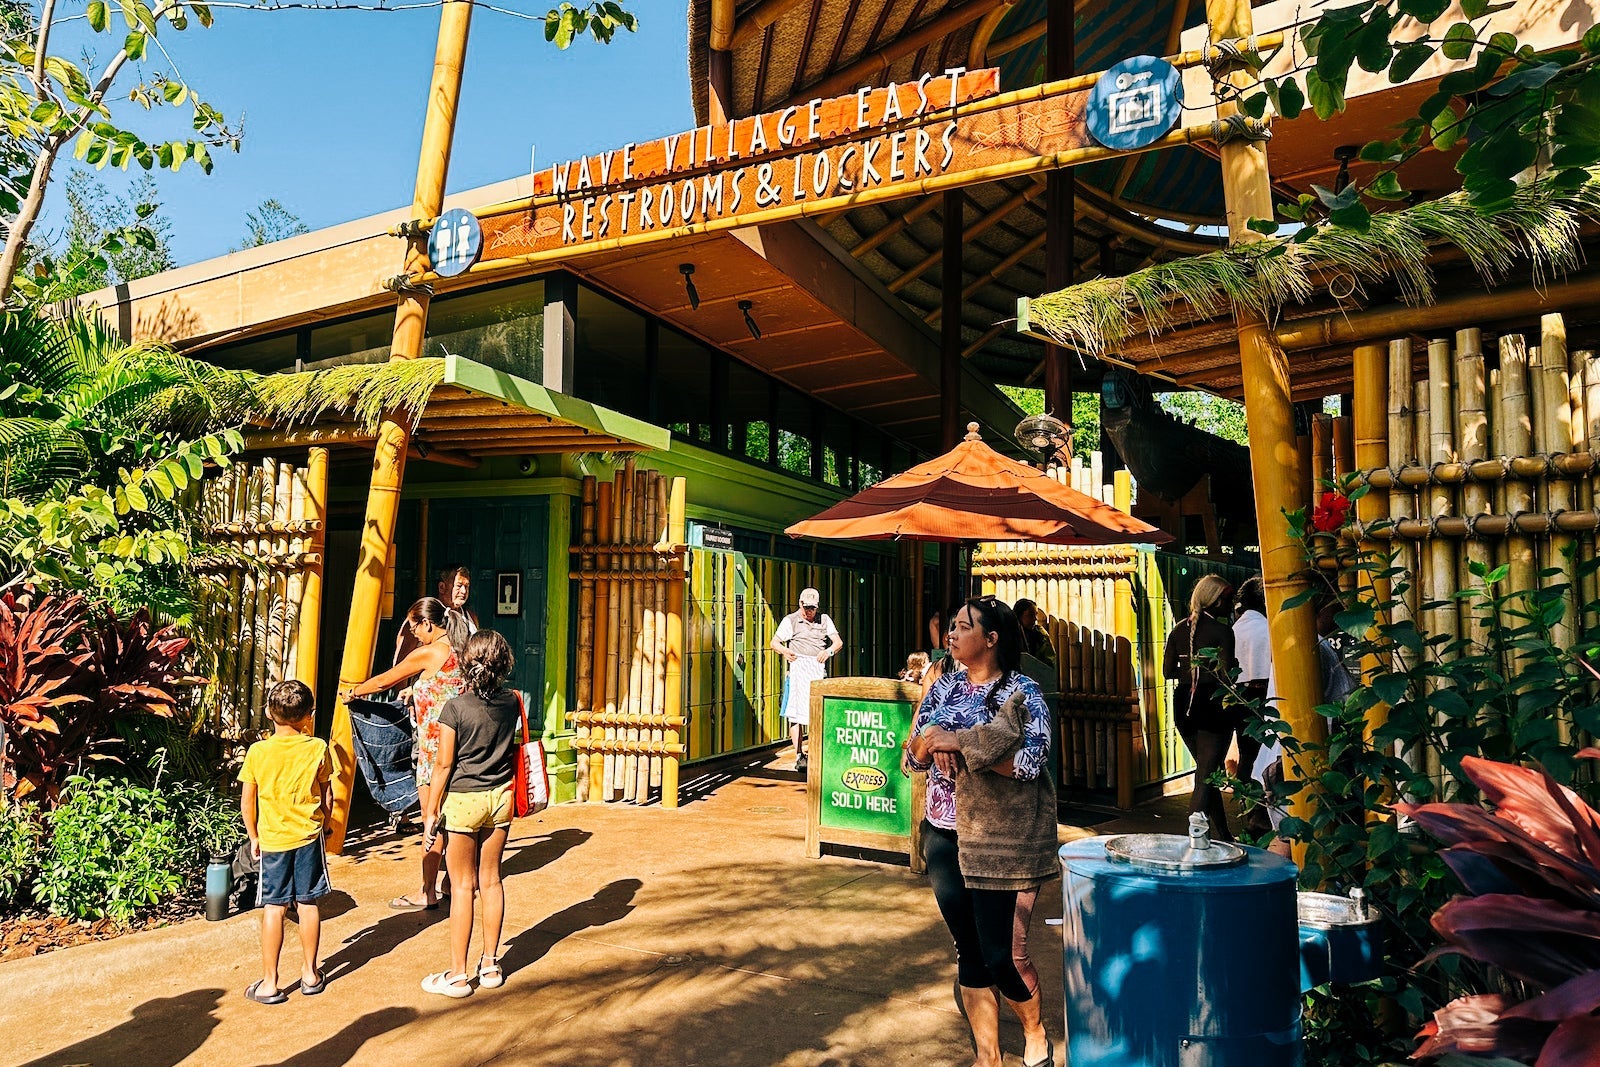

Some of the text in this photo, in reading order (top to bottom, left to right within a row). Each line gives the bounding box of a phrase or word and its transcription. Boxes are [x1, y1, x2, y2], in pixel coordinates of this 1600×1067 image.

[552, 67, 966, 195] WAVE VILLAGE EAST
[561, 121, 958, 244] RESTROOMS & LOCKERS
[844, 709, 886, 730] TOWEL
[835, 726, 896, 749] RENTALS
[850, 746, 879, 766] AND
[845, 771, 884, 789] EXPRESS
[831, 791, 897, 814] SOLD HERE
